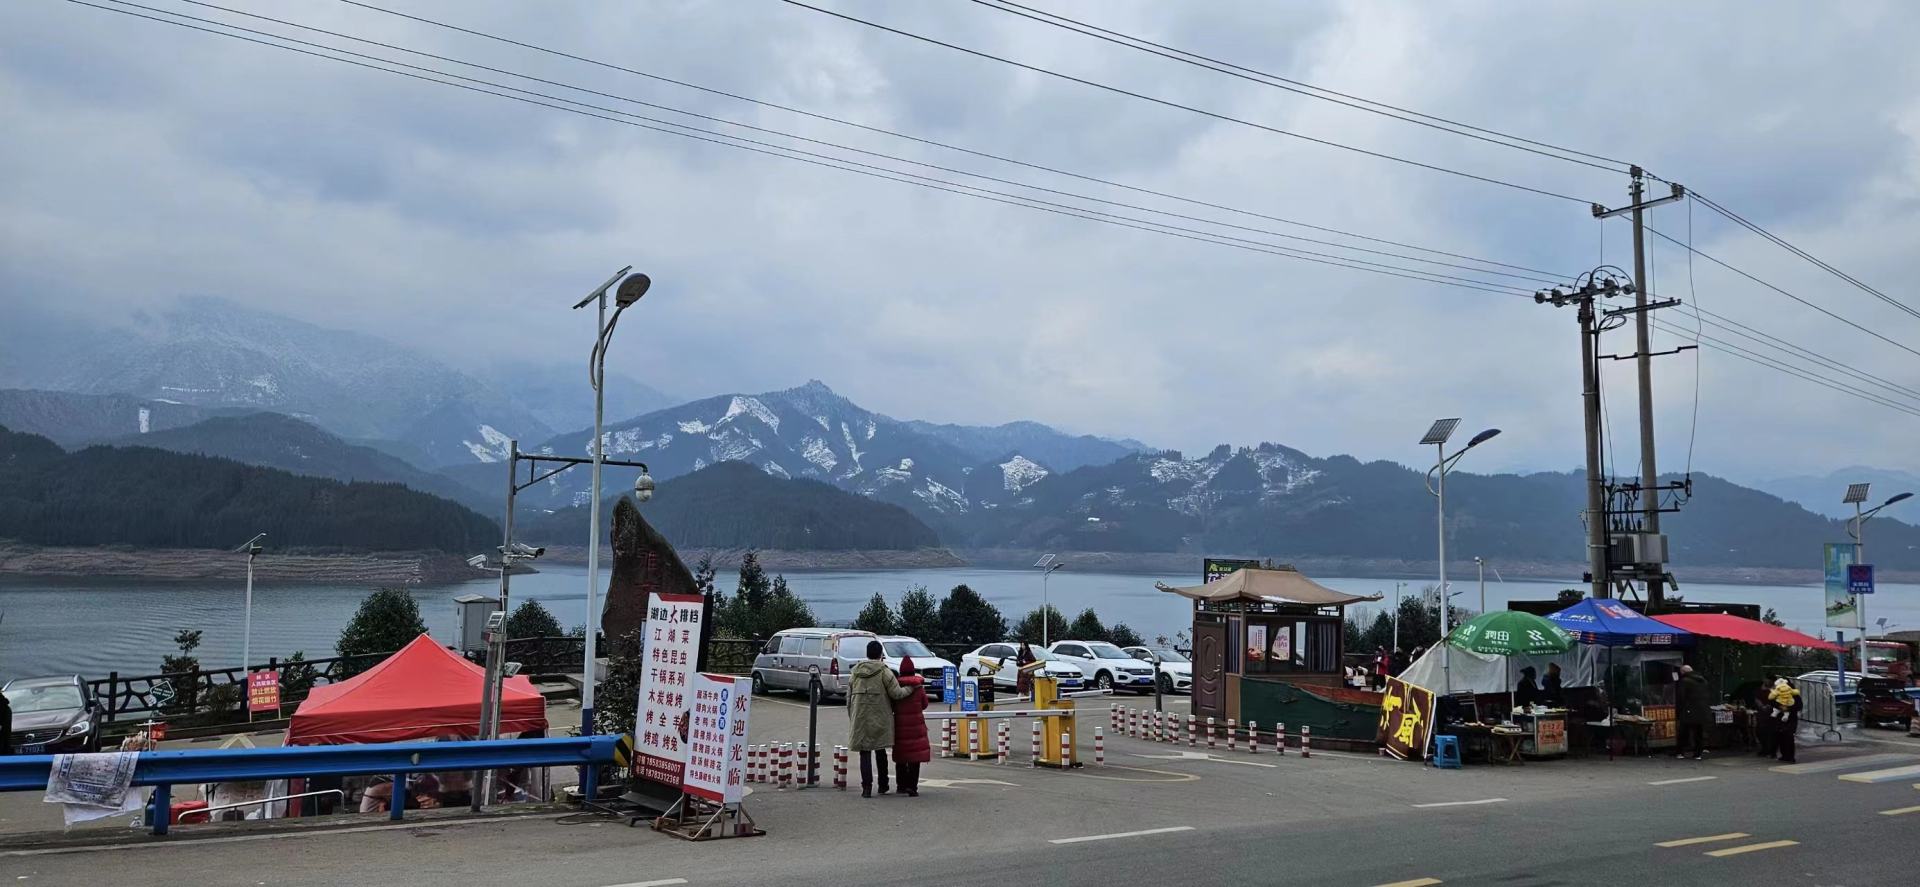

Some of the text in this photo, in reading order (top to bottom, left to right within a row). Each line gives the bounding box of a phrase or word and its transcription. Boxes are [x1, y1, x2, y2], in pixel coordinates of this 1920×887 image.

[650, 604, 699, 624] 湖边大排档
[654, 627, 690, 644] 江湖菜
[652, 647, 688, 665] 特色昆虫
[650, 668, 686, 687] 干锅系列
[647, 688, 684, 709] 木炭烧烤
[644, 709, 682, 733] 烤全羊
[643, 729, 679, 752] 烤鸡 烤兔
[726, 694, 748, 787] 欢迎光临
